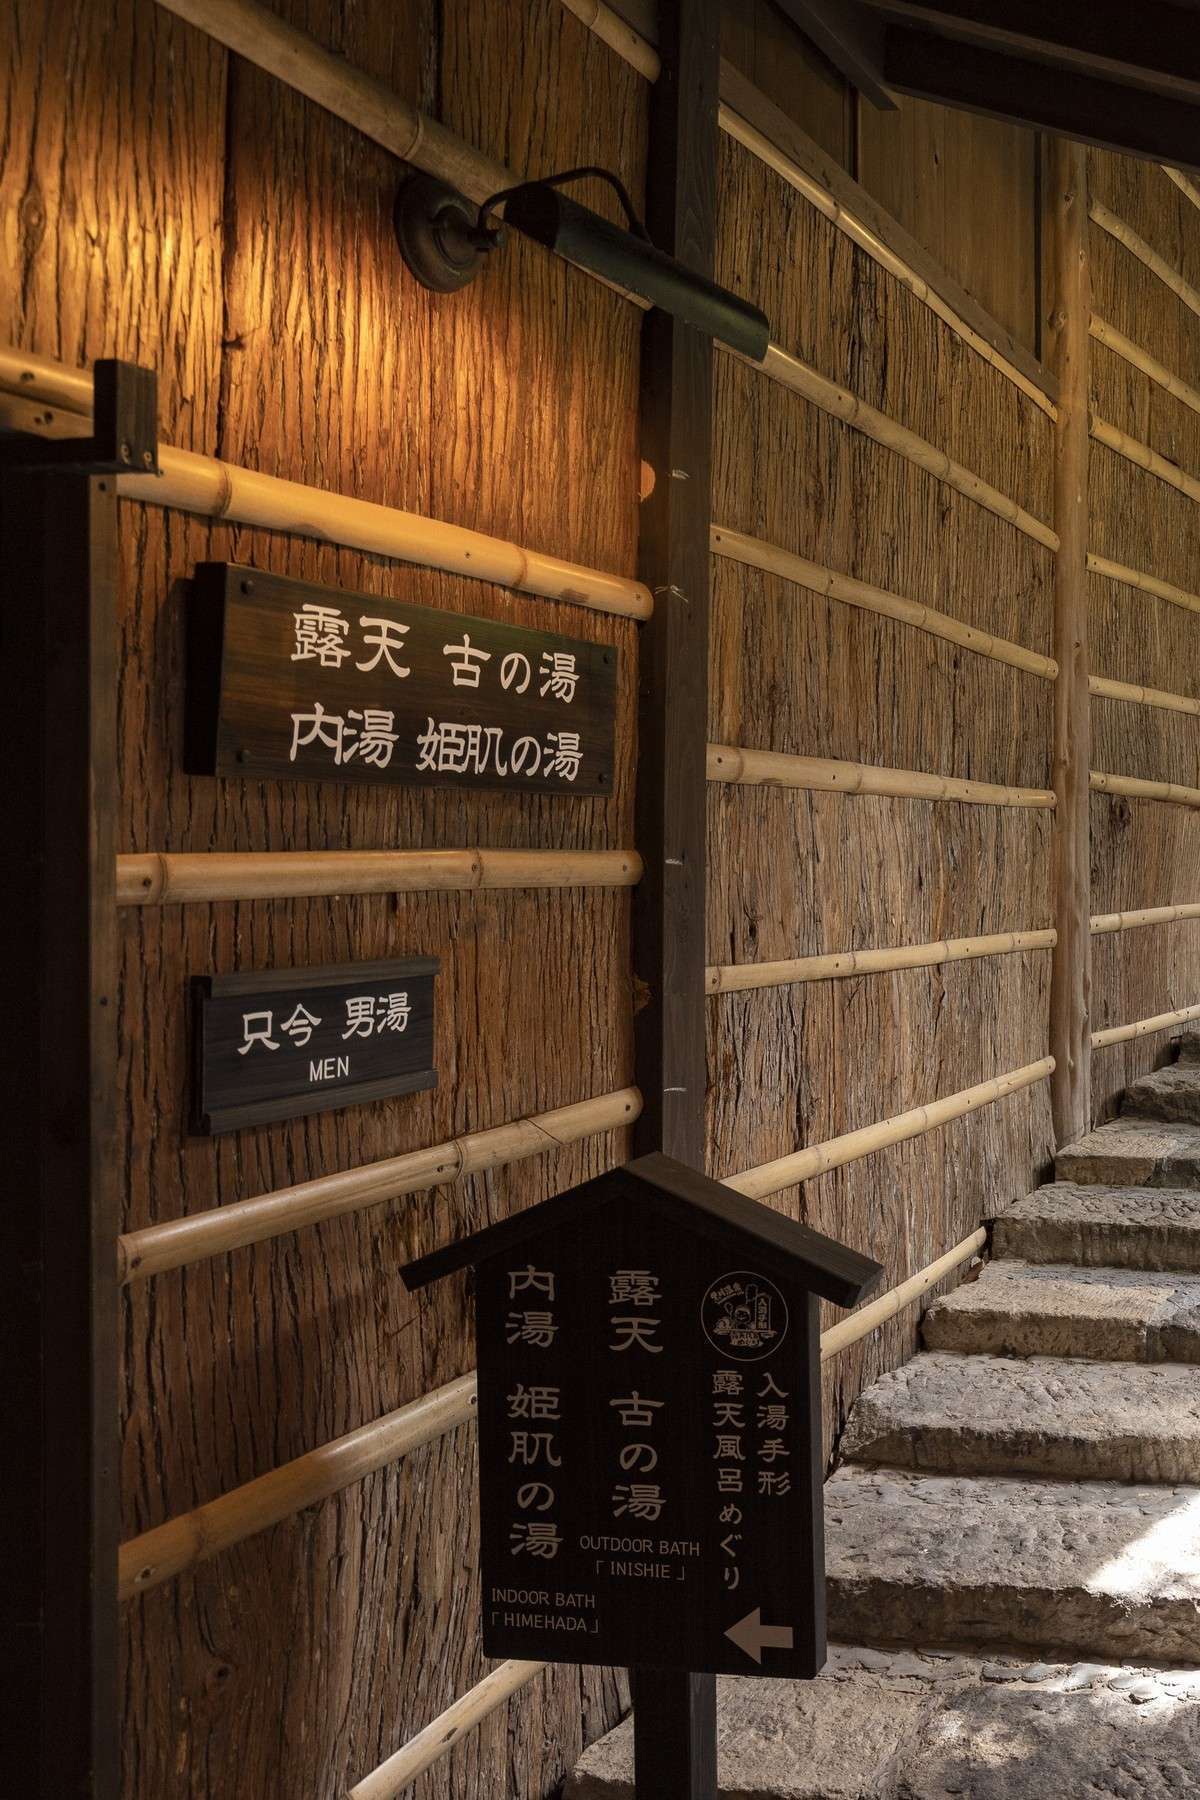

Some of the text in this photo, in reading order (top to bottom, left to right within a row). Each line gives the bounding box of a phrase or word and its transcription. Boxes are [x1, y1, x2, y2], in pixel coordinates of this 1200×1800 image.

[291, 604, 580, 704] 露天 古の湯
[290, 702, 584, 781] 内湯 姫肌の湯
[237, 991, 412, 1055] 只今 男湯
[309, 1055, 349, 1082] MEN
[505, 1264, 563, 1560] 内湯 姫肌の湯
[608, 1269, 667, 1522] 露天 古の湯
[756, 1372, 792, 1497] 入湯手形
[711, 1369, 747, 1591] 露天風呂めぐり
[580, 1535, 701, 1557] OUTDOOR BATH
[491, 1587, 596, 1609] INDOOR BATH
